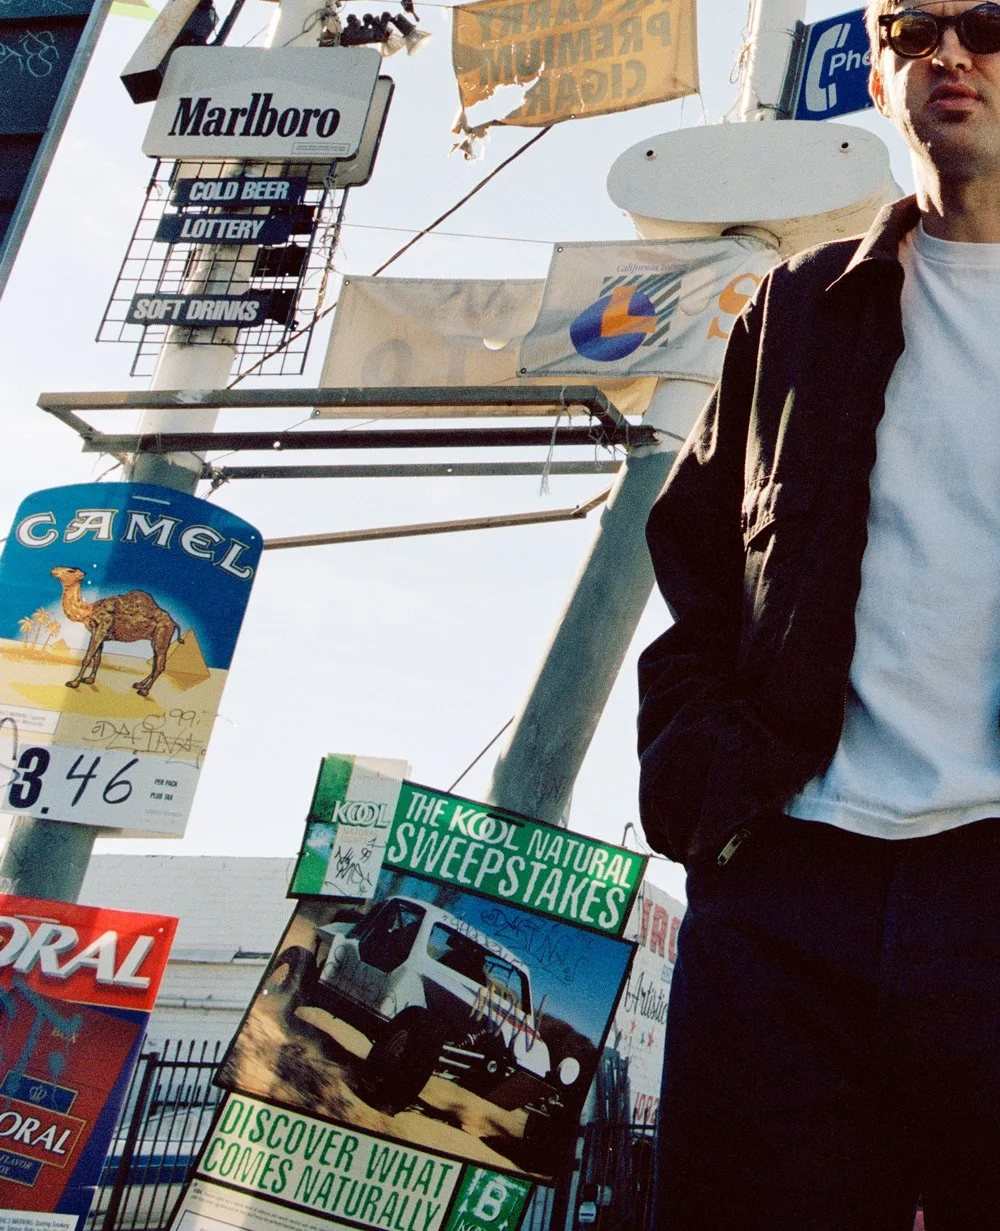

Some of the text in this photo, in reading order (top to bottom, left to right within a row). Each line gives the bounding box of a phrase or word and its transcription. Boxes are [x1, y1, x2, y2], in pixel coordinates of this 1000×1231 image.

[170, 93, 341, 138] Marlboro
[189, 181, 290, 201] COLD BEER
[180, 219, 266, 240] LOTTERY
[133, 298, 260, 321] SOFT DRINKS
[15, 508, 255, 580] CAMEL
[331, 800, 391, 829] KOOL
[406, 791, 633, 889] THE KOOL NATURAL
[387, 822, 626, 929] SWEEPSTAKES
[219, 1099, 454, 1199] DISCOVER WHAT
[203, 1137, 293, 1195] COMES
[294, 1164, 442, 1231] NATURALLY
